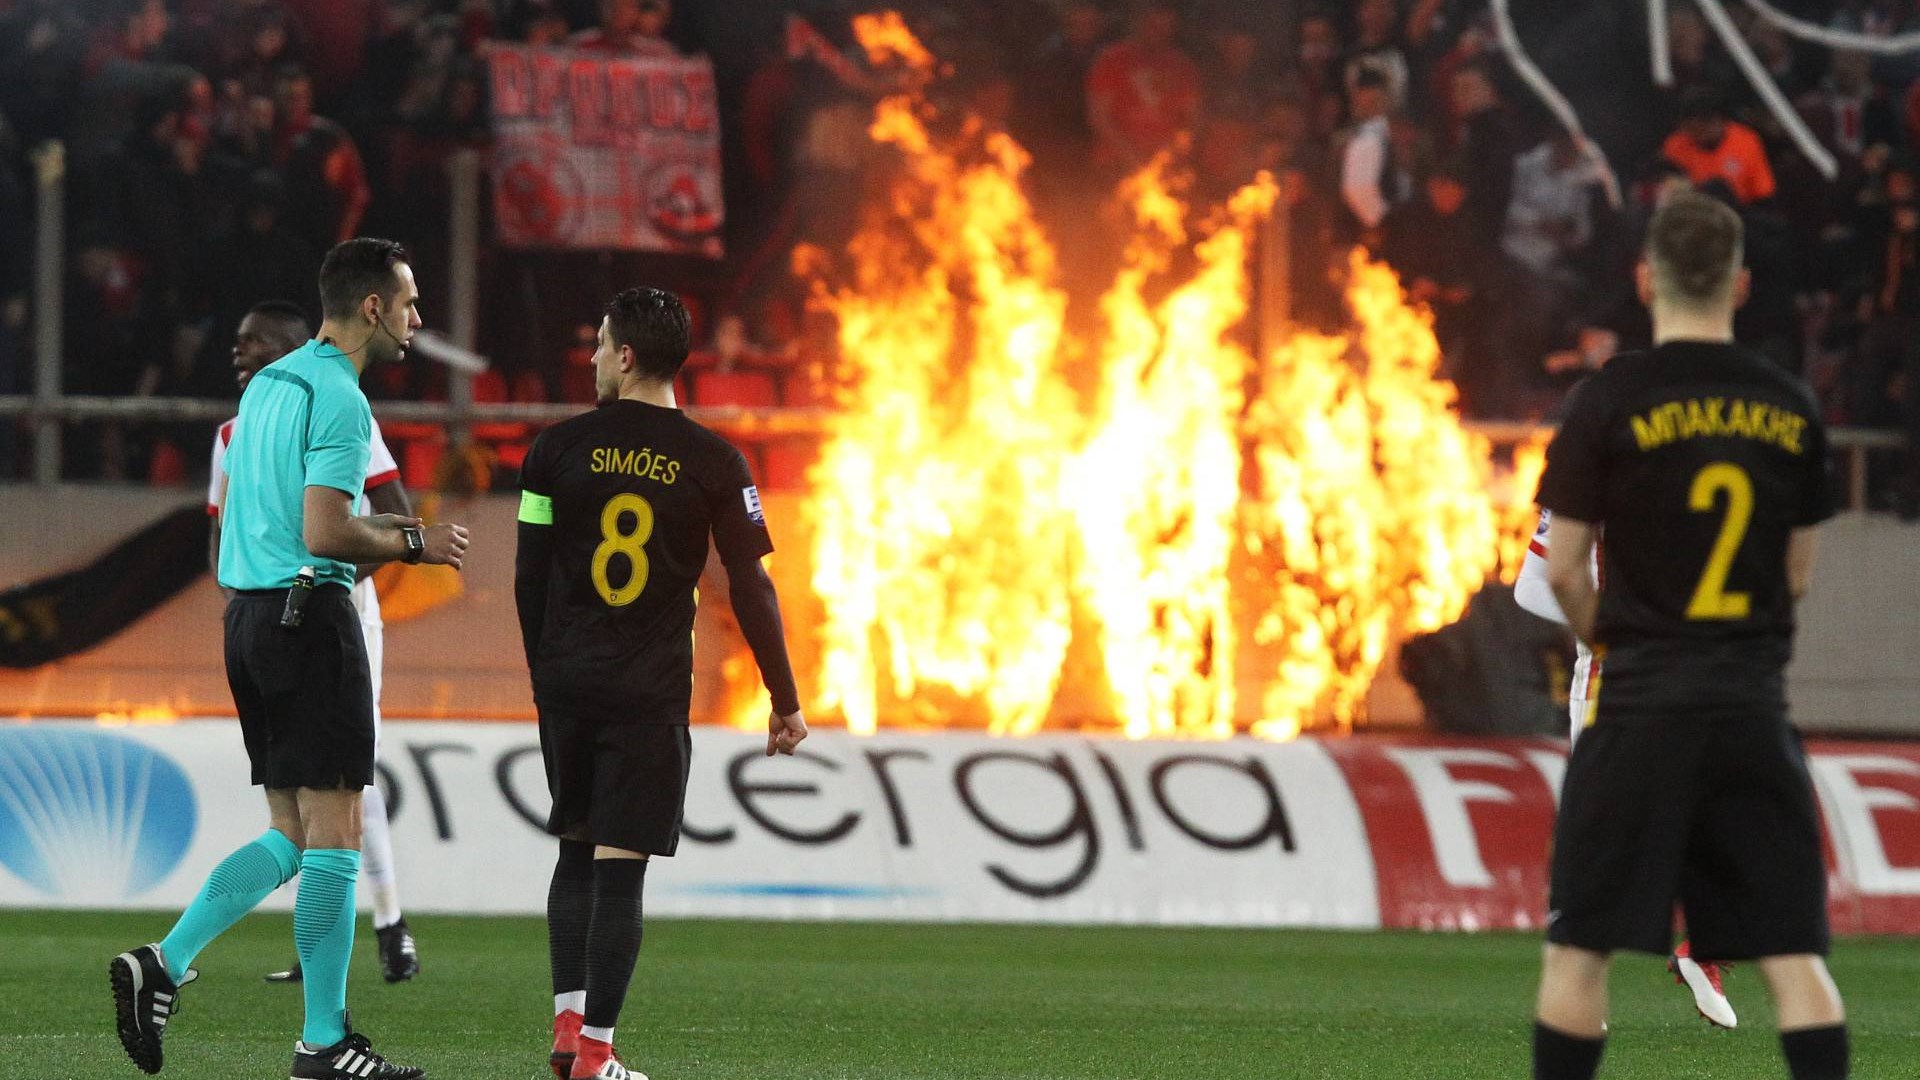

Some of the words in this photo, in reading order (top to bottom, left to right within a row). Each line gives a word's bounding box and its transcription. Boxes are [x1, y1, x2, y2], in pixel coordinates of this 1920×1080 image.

[590, 447, 680, 485] SIMÕES
[591, 492, 654, 607] 8
[1685, 462, 1754, 620] 2
